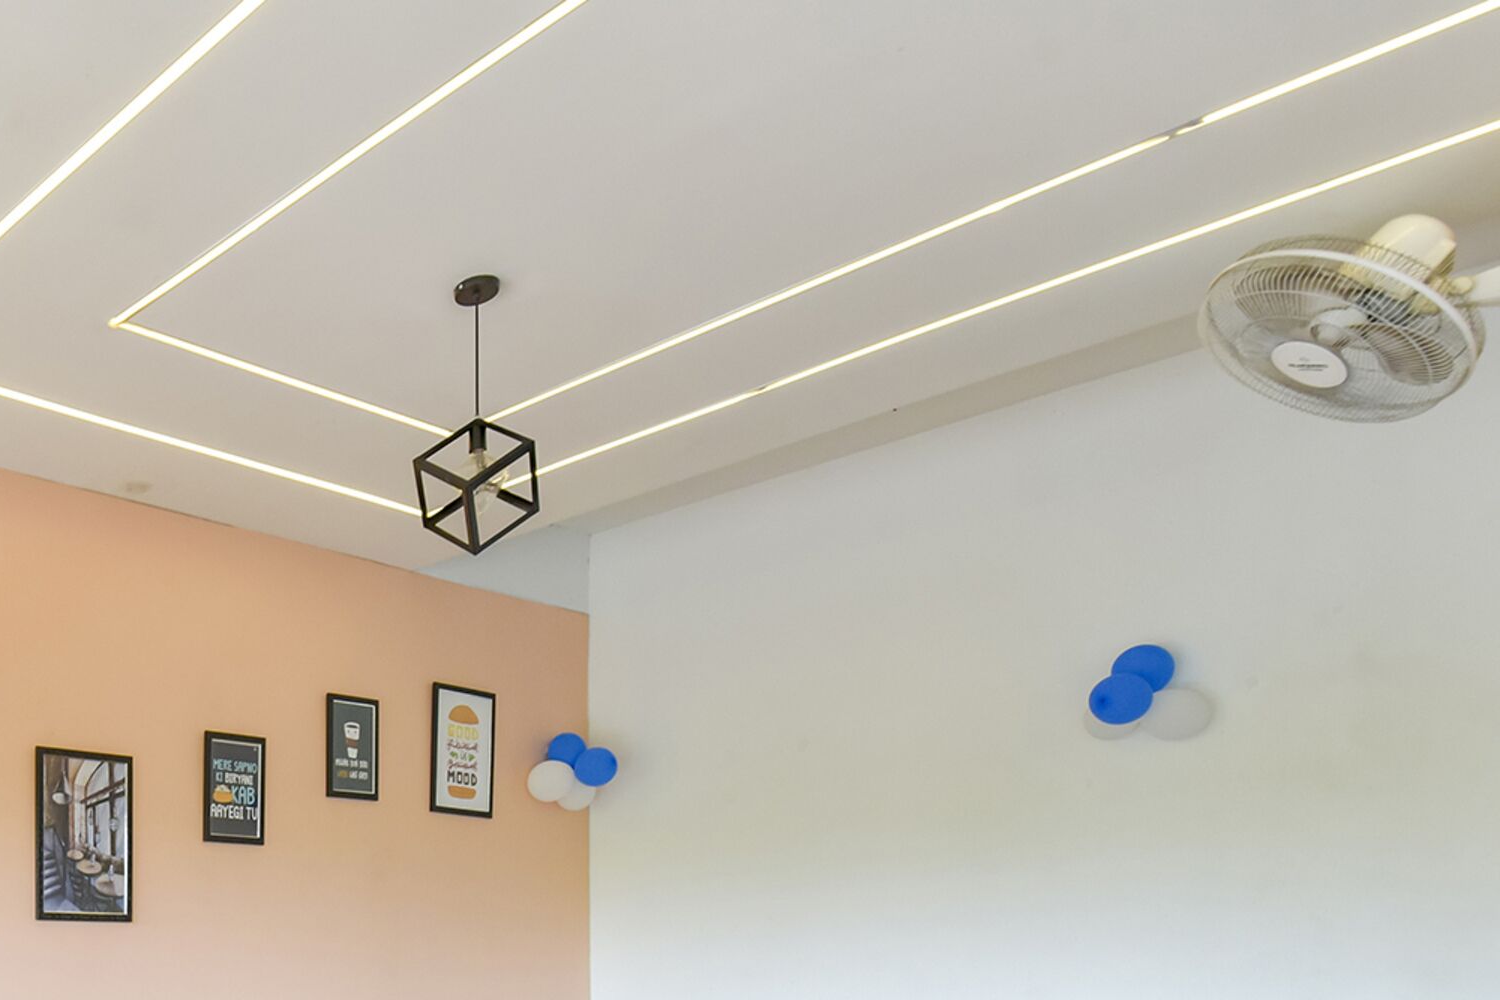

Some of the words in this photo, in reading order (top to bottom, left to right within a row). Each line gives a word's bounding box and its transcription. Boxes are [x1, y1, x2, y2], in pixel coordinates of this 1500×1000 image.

[212, 758, 232, 771] MERE
[233, 761, 257, 774] SAPNO
[447, 770, 478, 786] MOOD
[231, 785, 256, 805] KAB
[210, 803, 244, 820] AAYEGI
